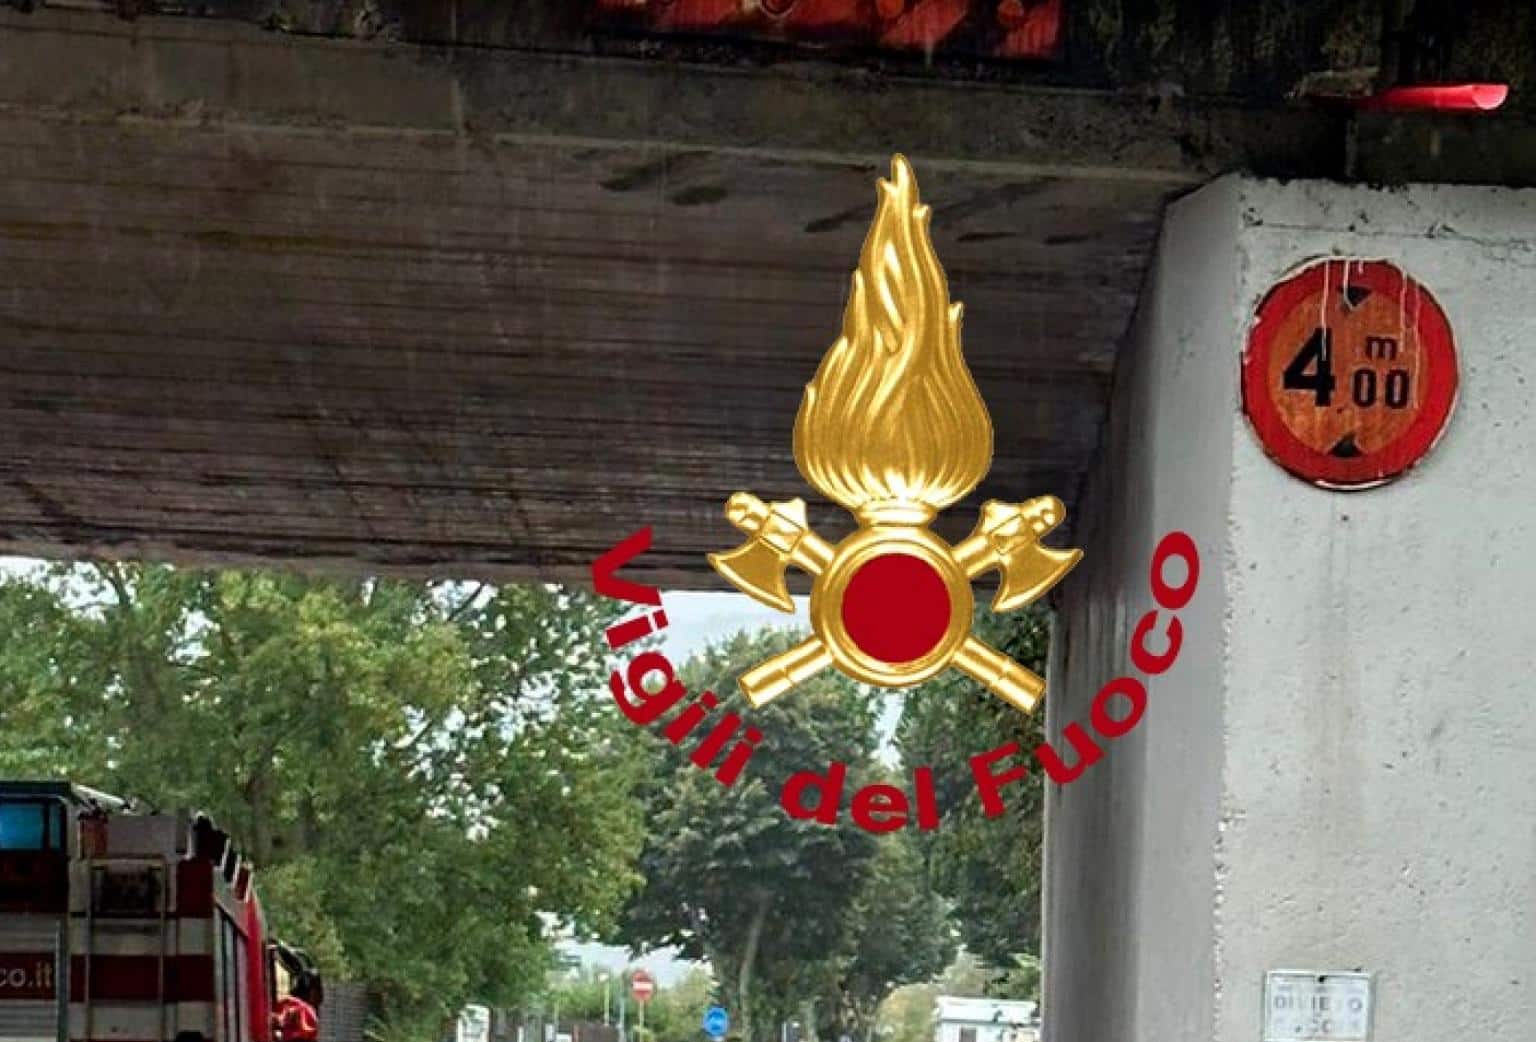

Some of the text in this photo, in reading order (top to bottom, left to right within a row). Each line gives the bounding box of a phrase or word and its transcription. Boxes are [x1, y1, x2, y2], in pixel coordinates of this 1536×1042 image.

[1282, 327, 1411, 410] 4 00
[1365, 336, 1399, 360] m
